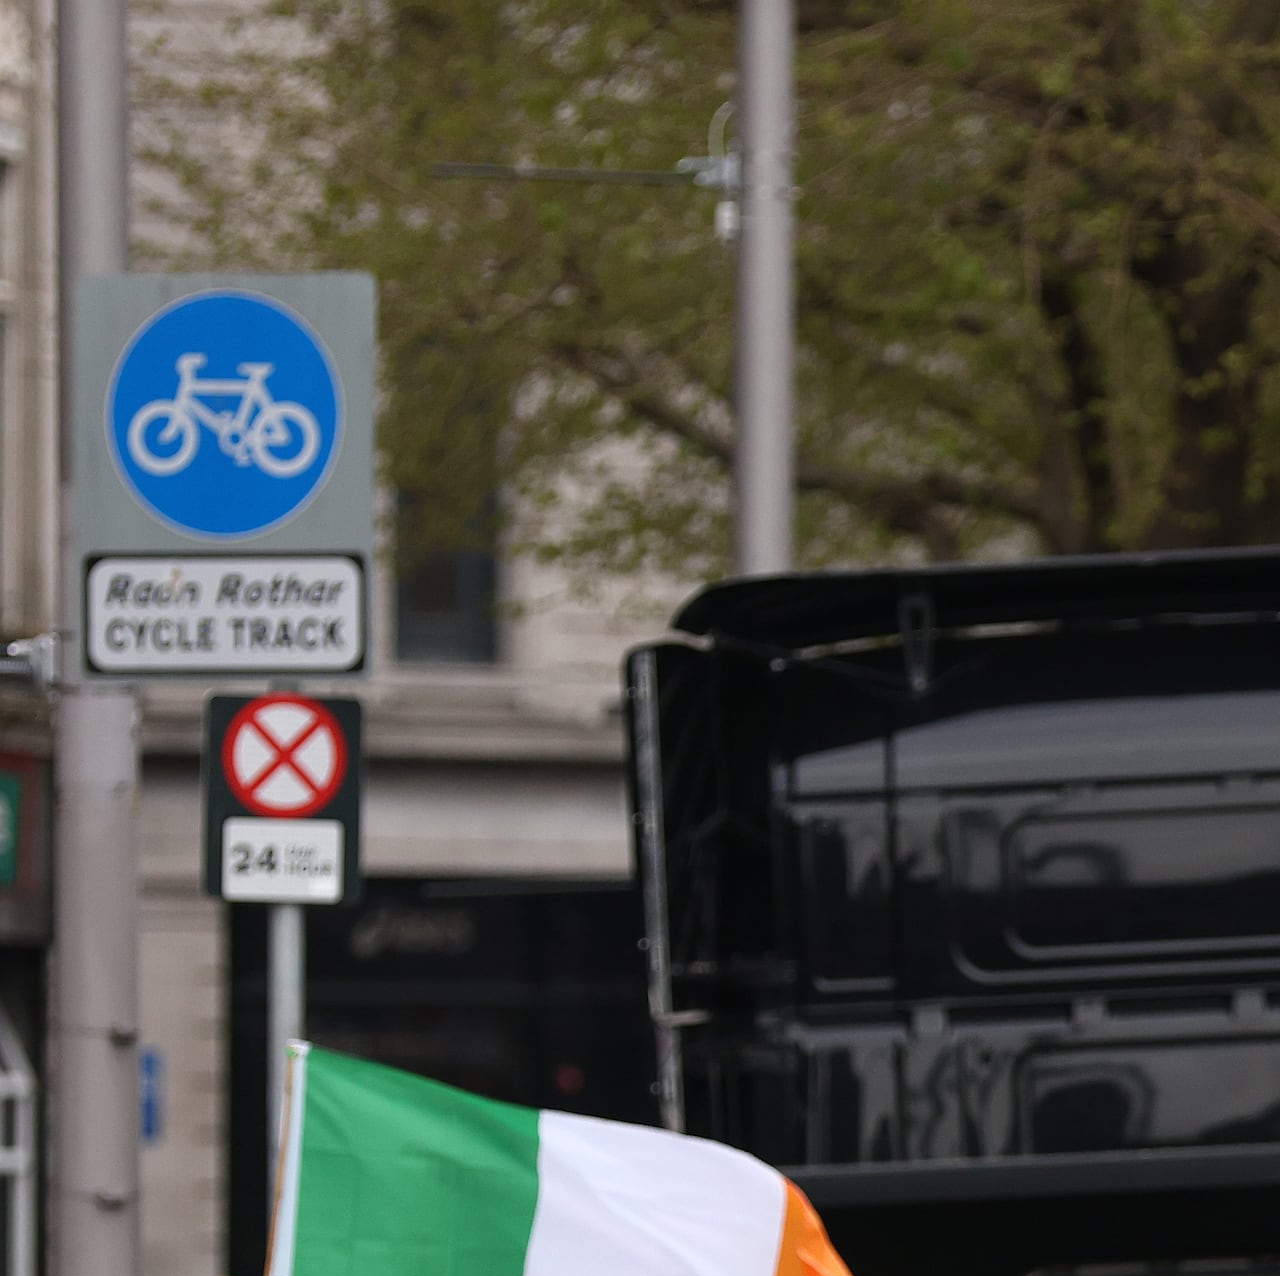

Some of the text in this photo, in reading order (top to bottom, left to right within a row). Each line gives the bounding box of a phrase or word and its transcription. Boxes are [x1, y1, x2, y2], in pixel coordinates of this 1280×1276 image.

[104, 617, 345, 651] CYCLE TRACK
[231, 843, 276, 874] 24
